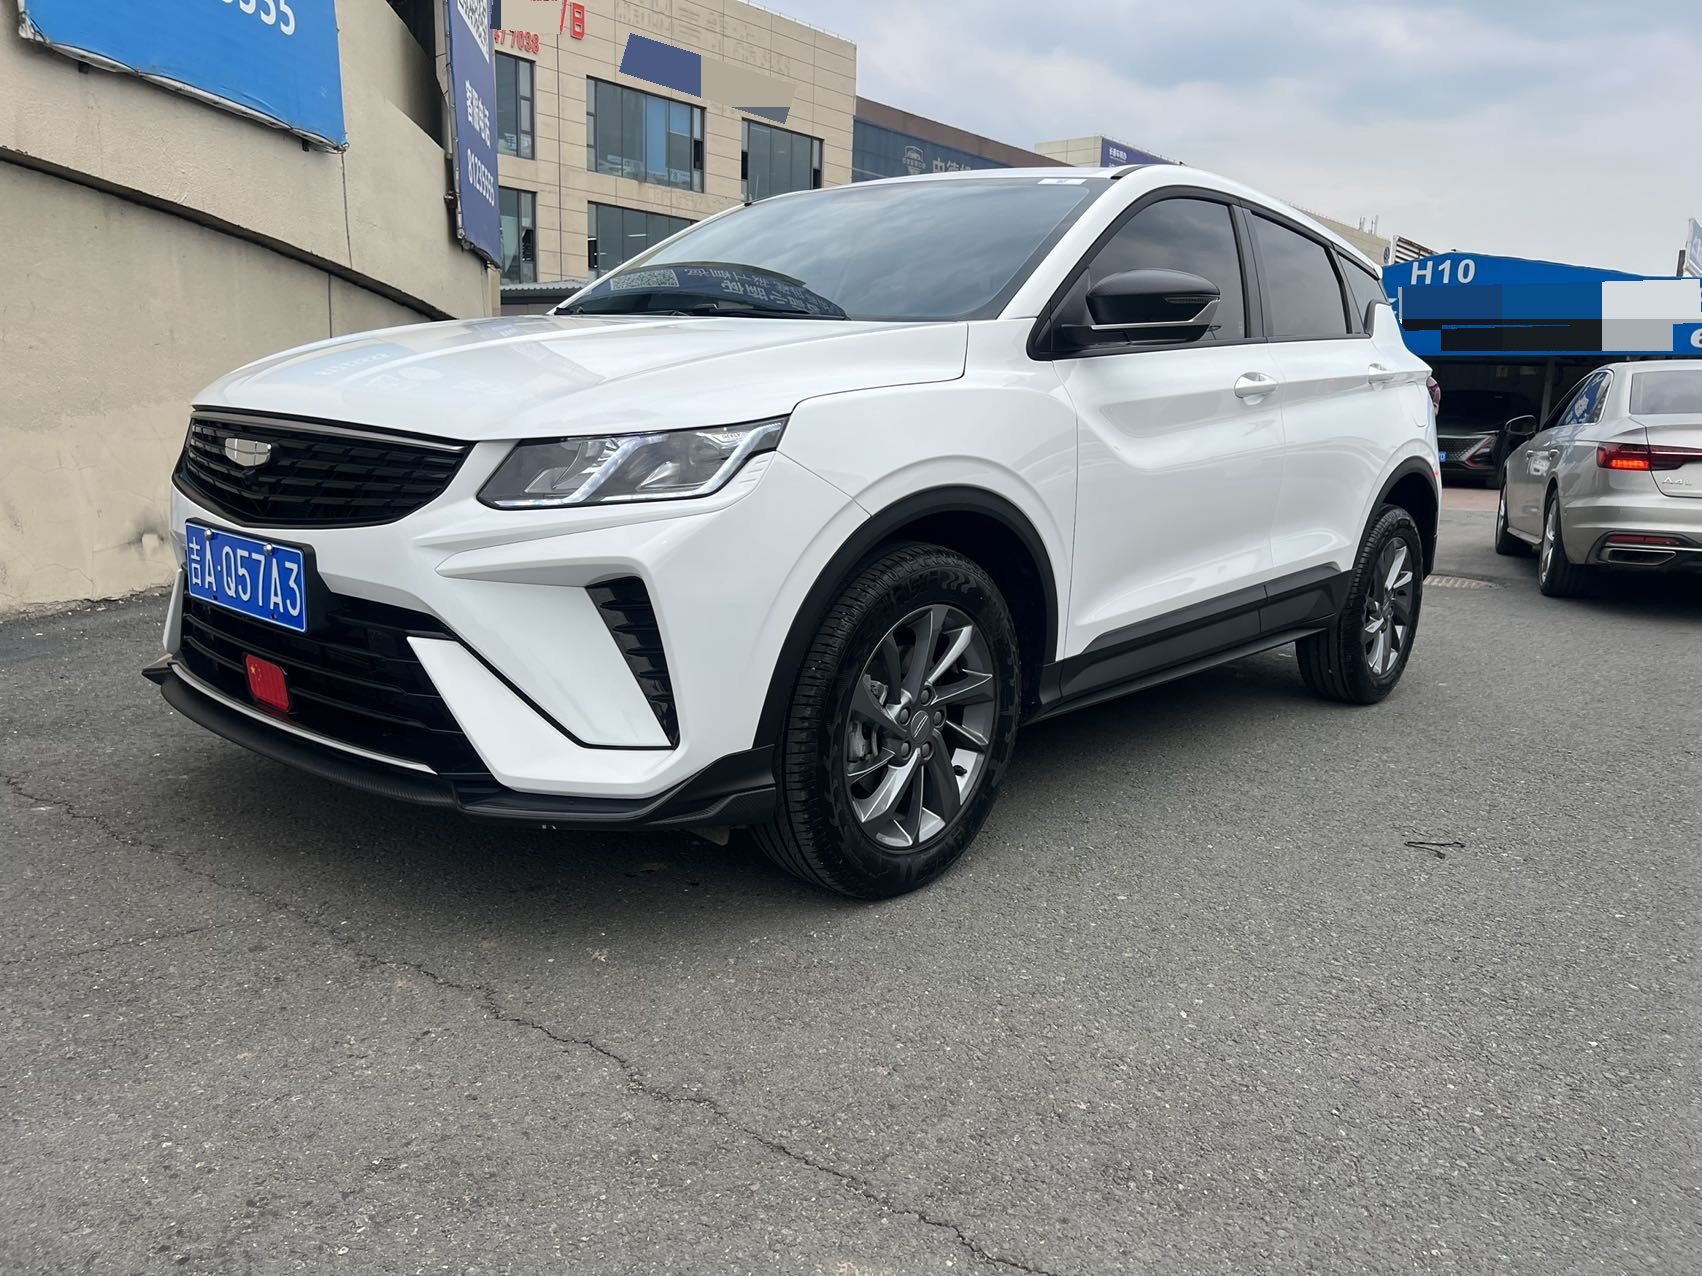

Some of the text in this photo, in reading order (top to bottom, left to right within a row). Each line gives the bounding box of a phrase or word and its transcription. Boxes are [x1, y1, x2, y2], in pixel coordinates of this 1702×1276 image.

[465, 80, 491, 149] 客服电话
[467, 148, 495, 206] 81235555
[1411, 259, 1475, 285] H10
